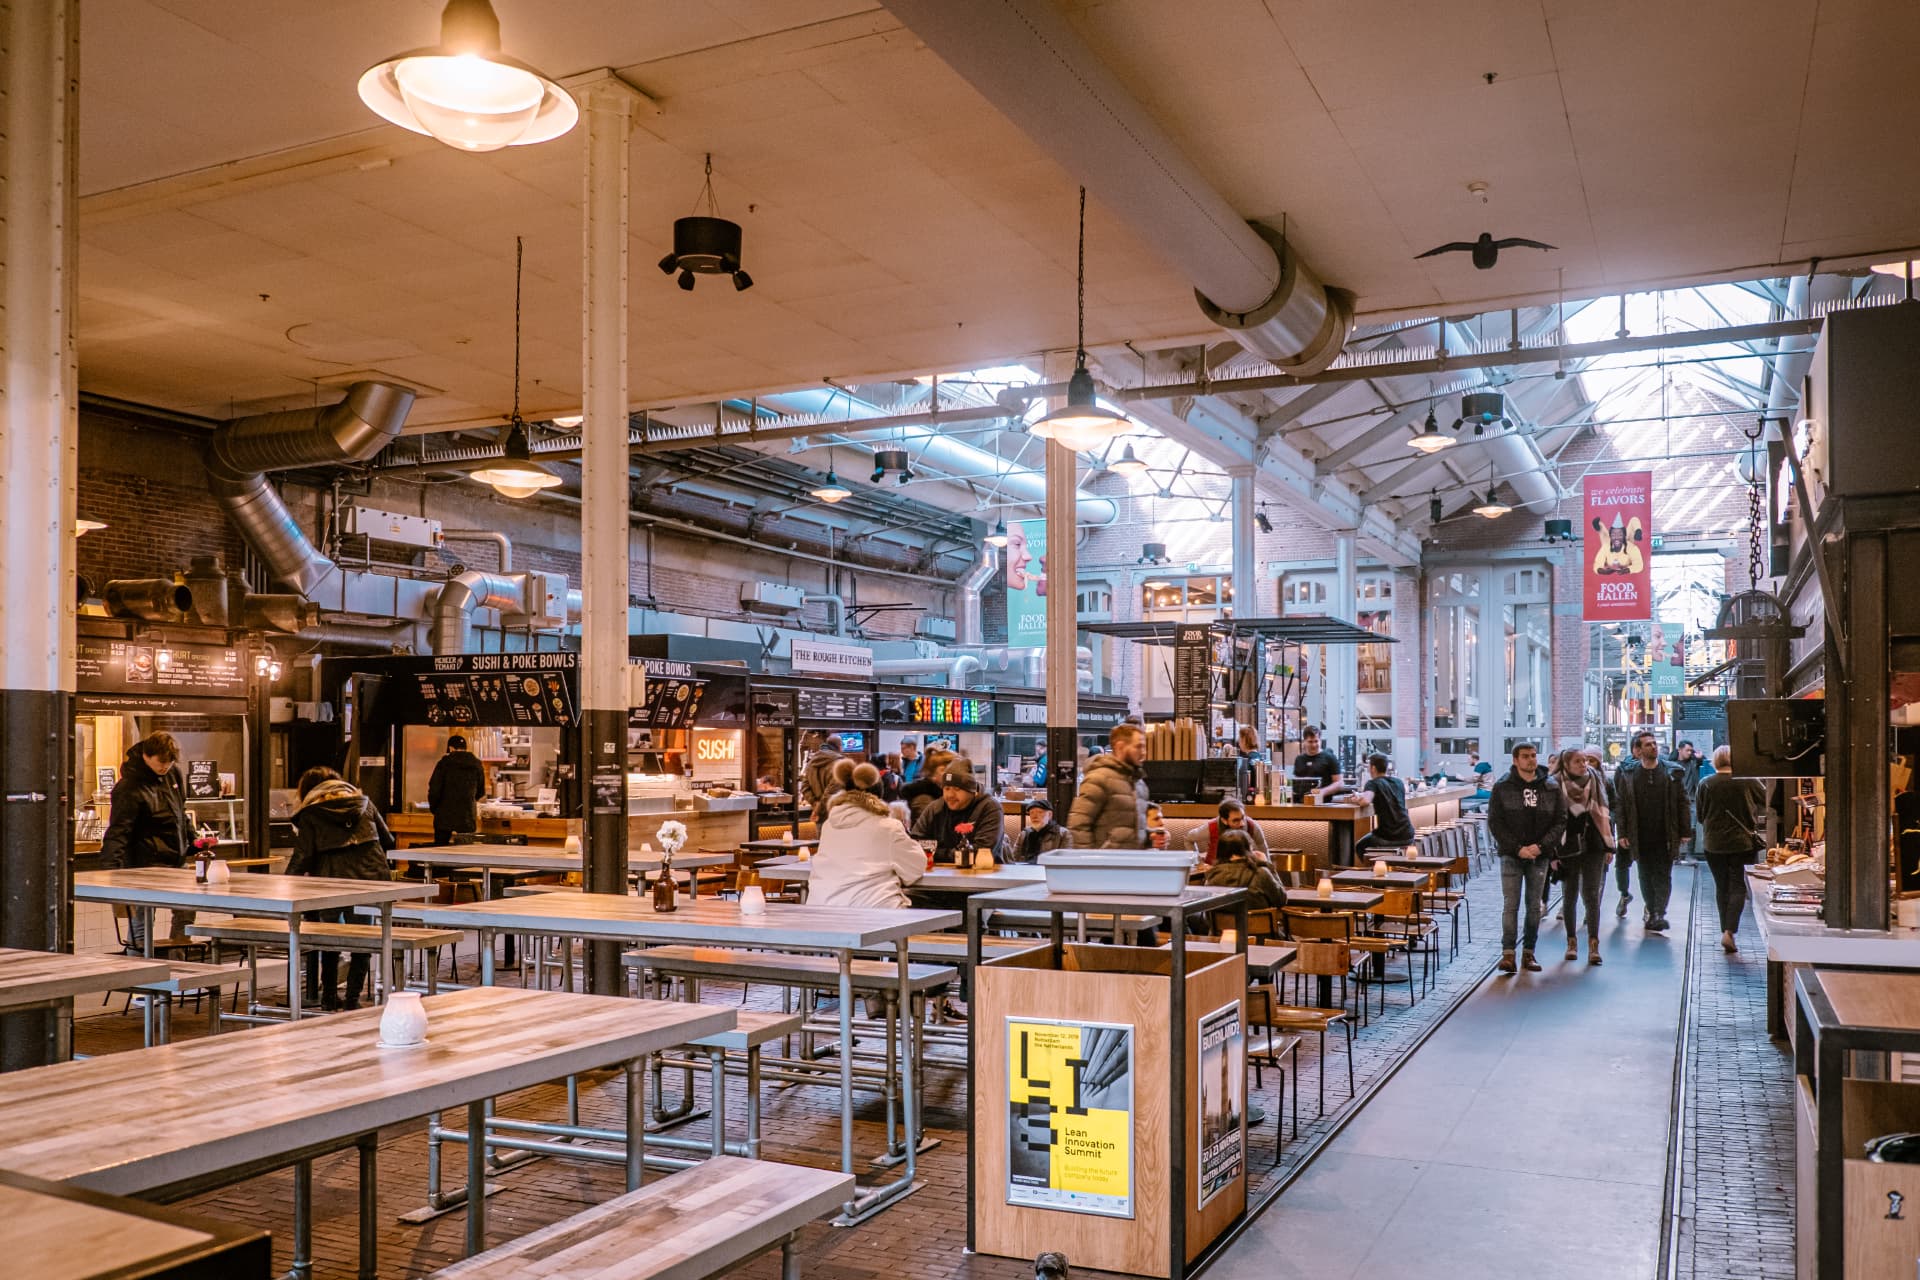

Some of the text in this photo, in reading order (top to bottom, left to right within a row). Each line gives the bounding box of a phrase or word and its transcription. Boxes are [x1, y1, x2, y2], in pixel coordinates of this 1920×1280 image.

[1605, 486, 1645, 495] celebrate
[1591, 495, 1645, 506] FLAVORS
[1600, 583, 1635, 593] FOOD
[1596, 592, 1638, 601] HALLEN
[1021, 614, 1045, 624] FOOD
[472, 654, 575, 670] SUSHI & POKE BOWLS
[794, 649, 872, 667] THE ROUGH KITCHEN
[645, 660, 665, 675] POKE
[665, 662, 692, 677] BOWLS
[697, 739, 735, 760] SUSHI
[1065, 1127, 1088, 1138] Lean
[1065, 1137, 1115, 1150] Innovation
[1064, 1146, 1101, 1159] Summit
[1064, 1164, 1088, 1172] Building
[1099, 1168, 1118, 1176] future
[1064, 1172, 1109, 1183] company today
